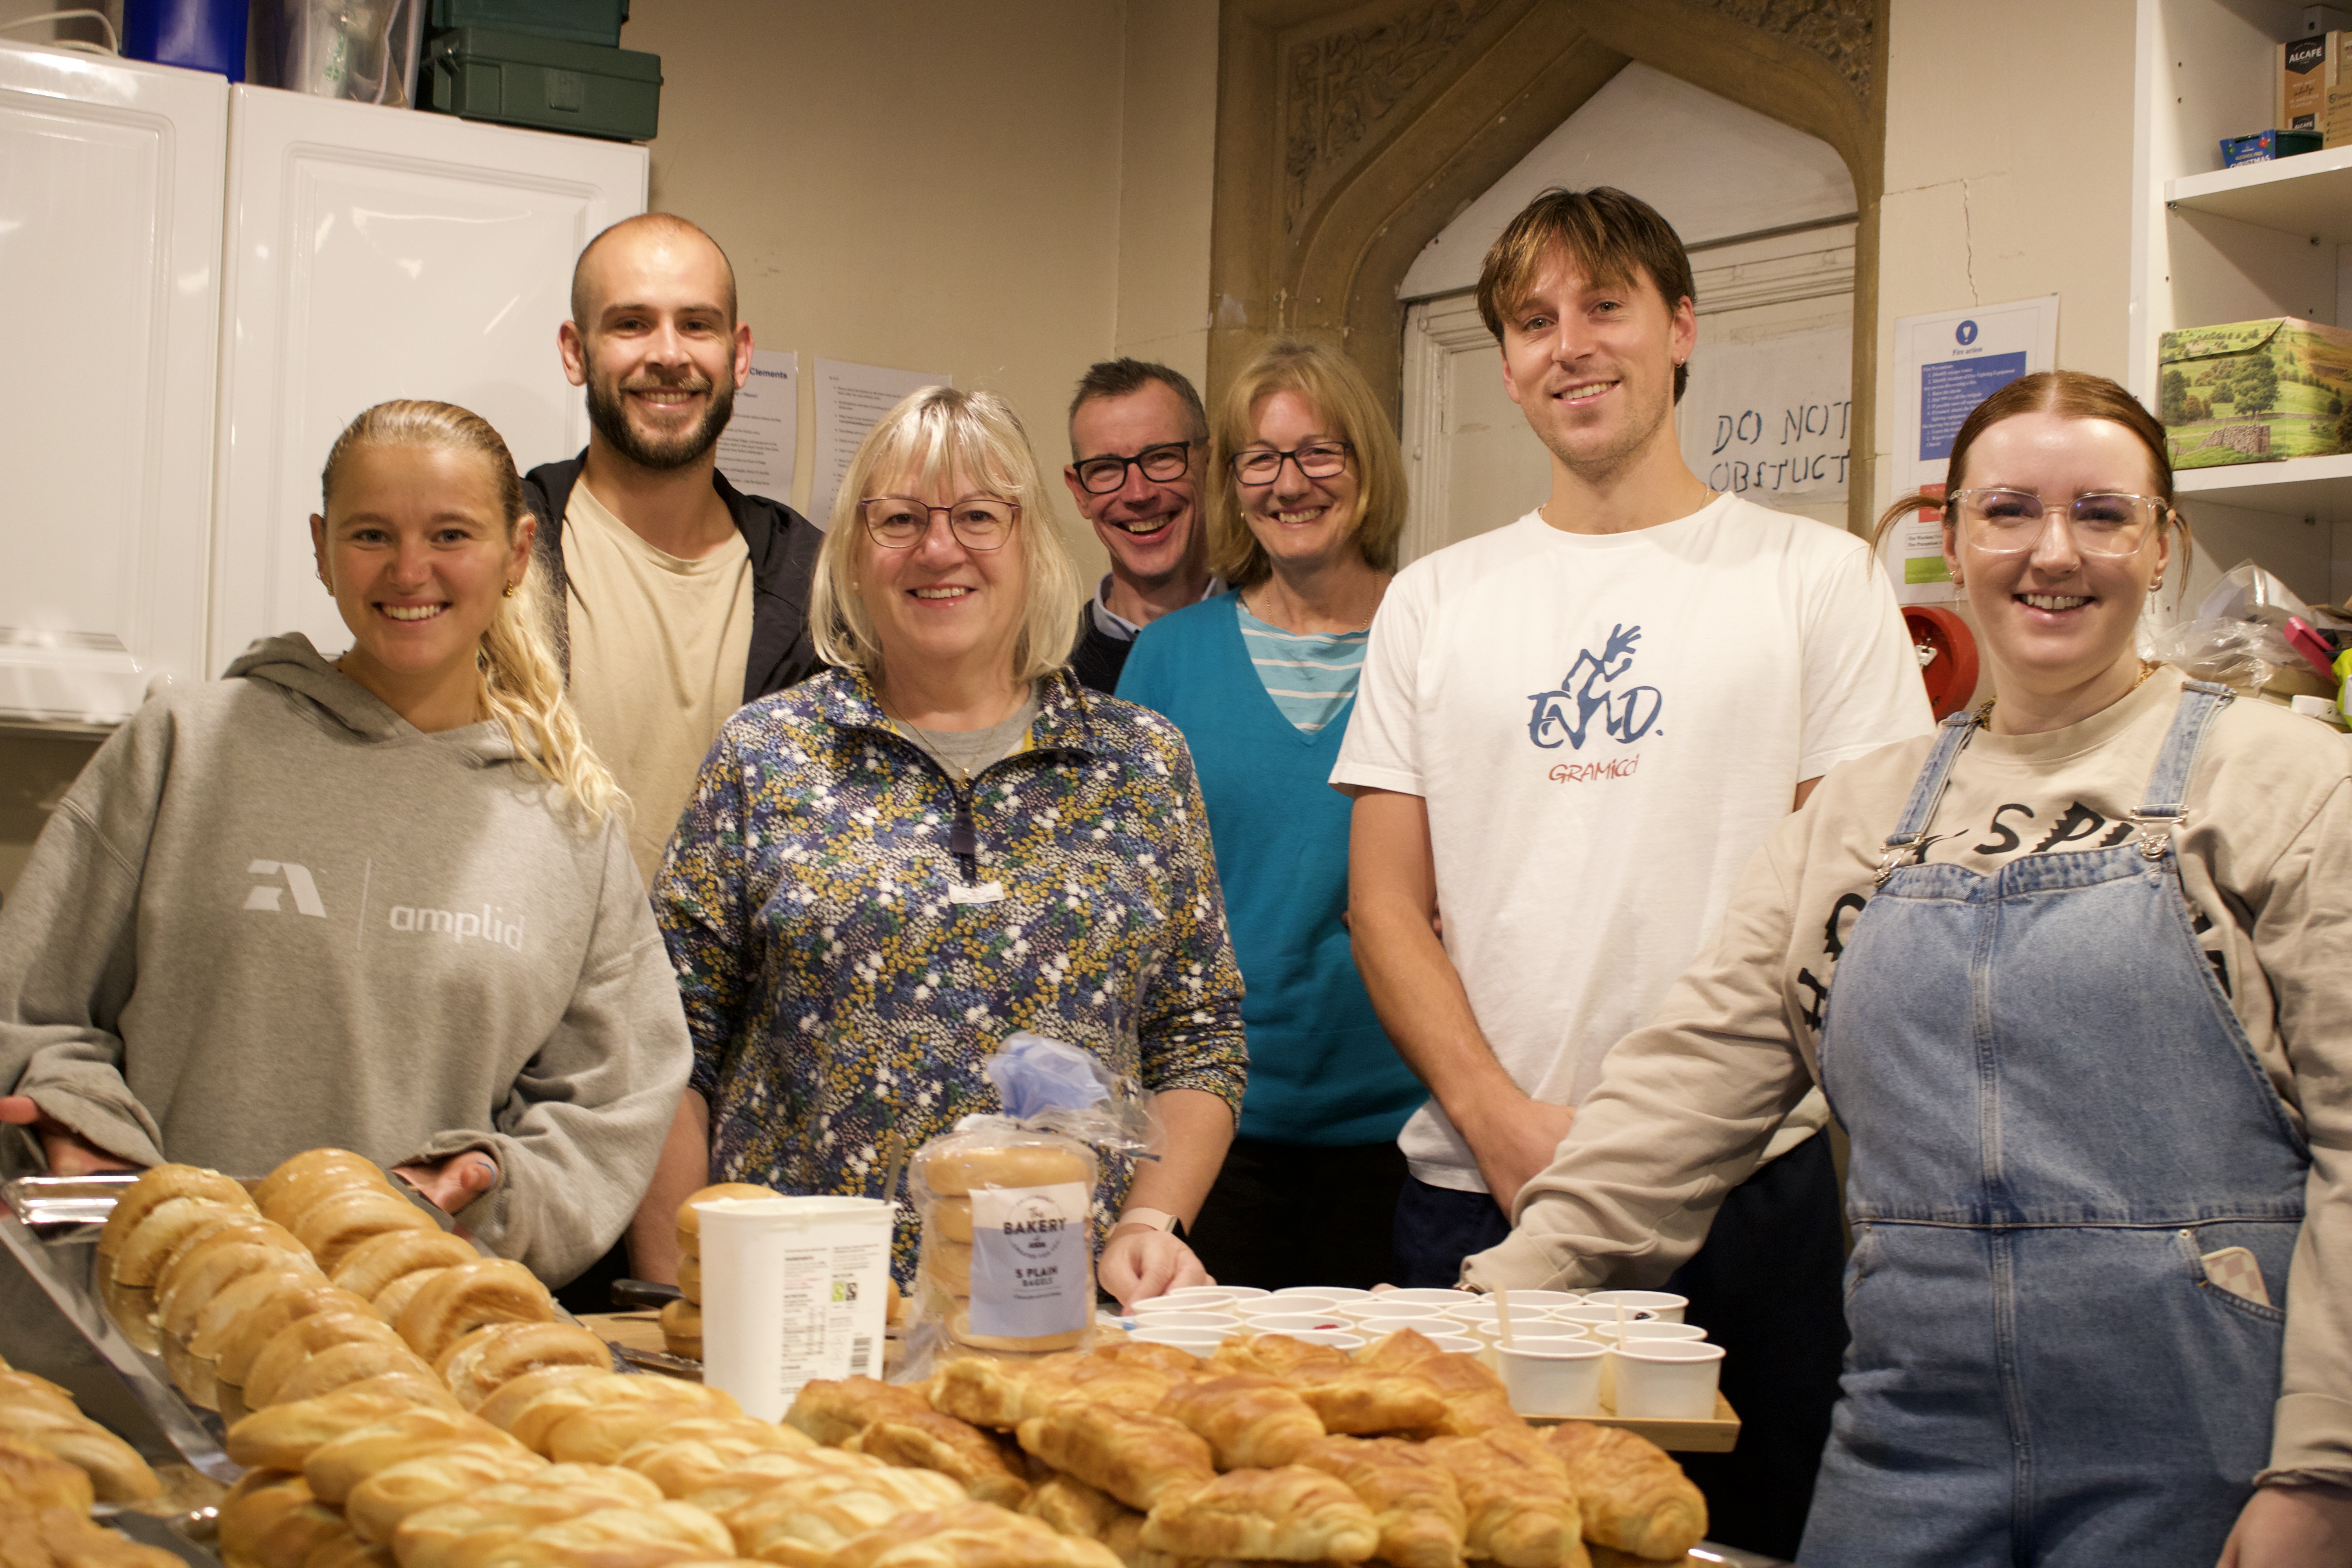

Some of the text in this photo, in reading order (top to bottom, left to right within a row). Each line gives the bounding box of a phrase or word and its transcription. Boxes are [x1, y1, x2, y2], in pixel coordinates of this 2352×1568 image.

[750, 367, 788, 379] Clements
[1712, 401, 1851, 455] DO NOT
[1710, 449, 1850, 492] OBSTUCT
[390, 903, 525, 953] amplid
[1004, 1217, 1067, 1235] BAKERY
[1026, 1265, 1058, 1278] PLAIN
